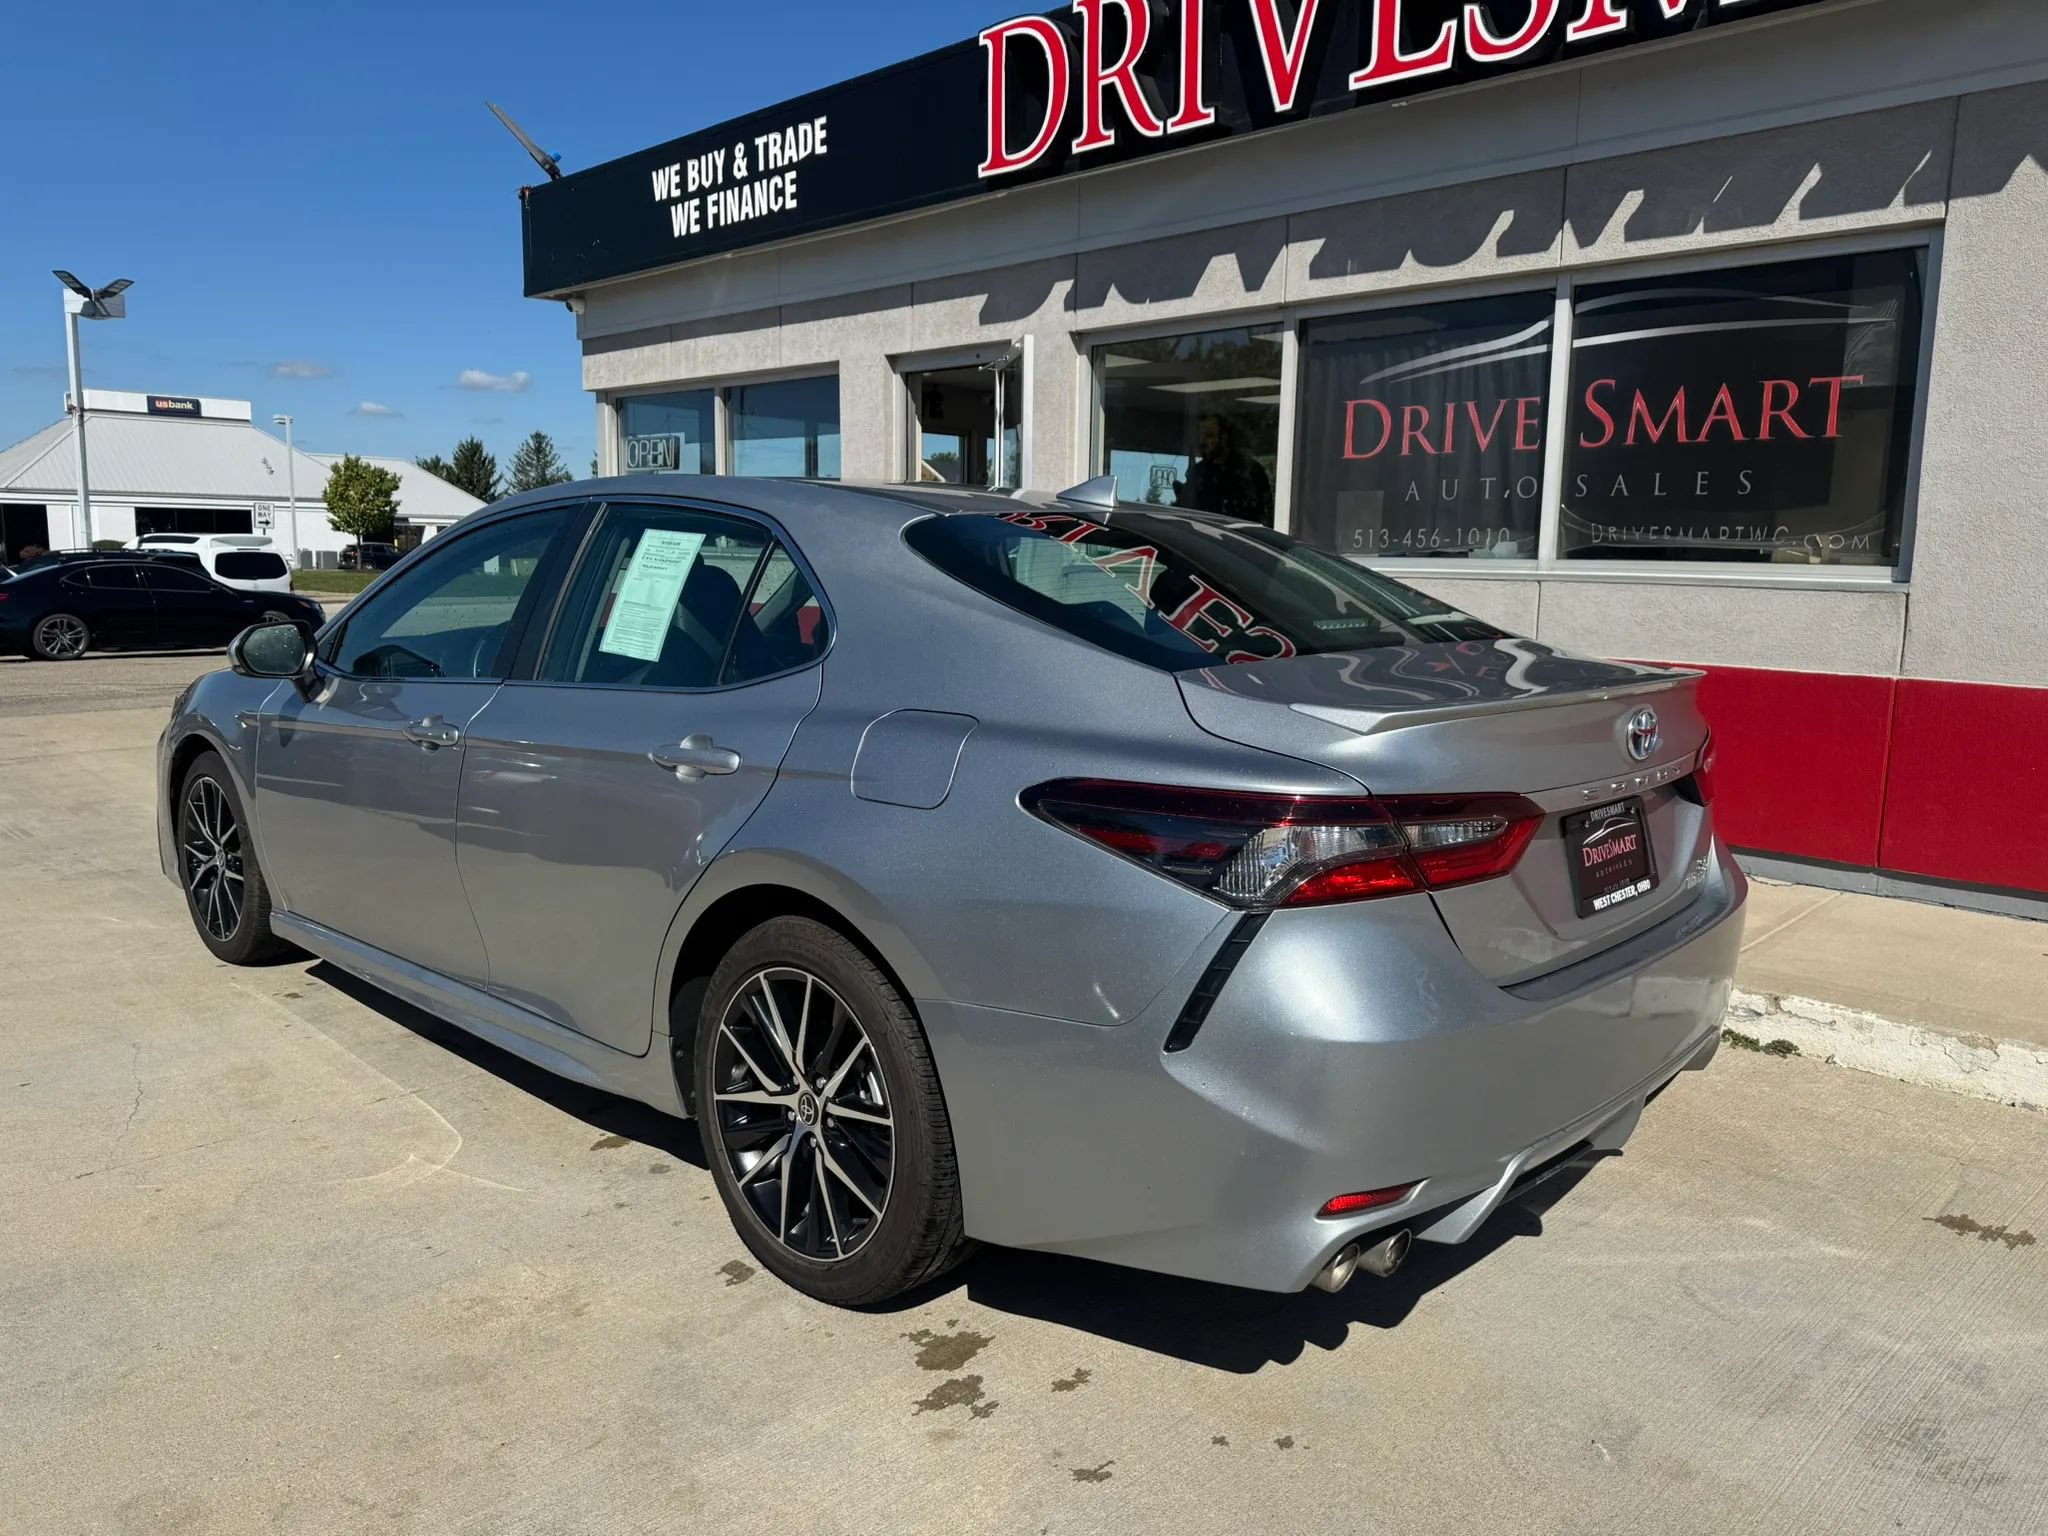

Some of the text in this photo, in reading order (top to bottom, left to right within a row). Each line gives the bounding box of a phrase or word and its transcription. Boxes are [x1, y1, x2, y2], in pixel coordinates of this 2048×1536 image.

[978, 0, 1752, 178] DRIV
[652, 115, 827, 202] WE BUY & TRADE
[670, 170, 797, 238] WE FINANCE
[1341, 374, 1864, 460] DRIVE SMART
[627, 436, 673, 468] OPEN
[1405, 469, 1753, 502] AUTO SALES
[258, 511, 271, 519] WAY
[1353, 527, 1510, 549] 513-456-1010
[1590, 802, 1626, 822] DRIVESMART
[1593, 894, 1611, 911] WEST
[1611, 885, 1638, 905] CHESTER,
